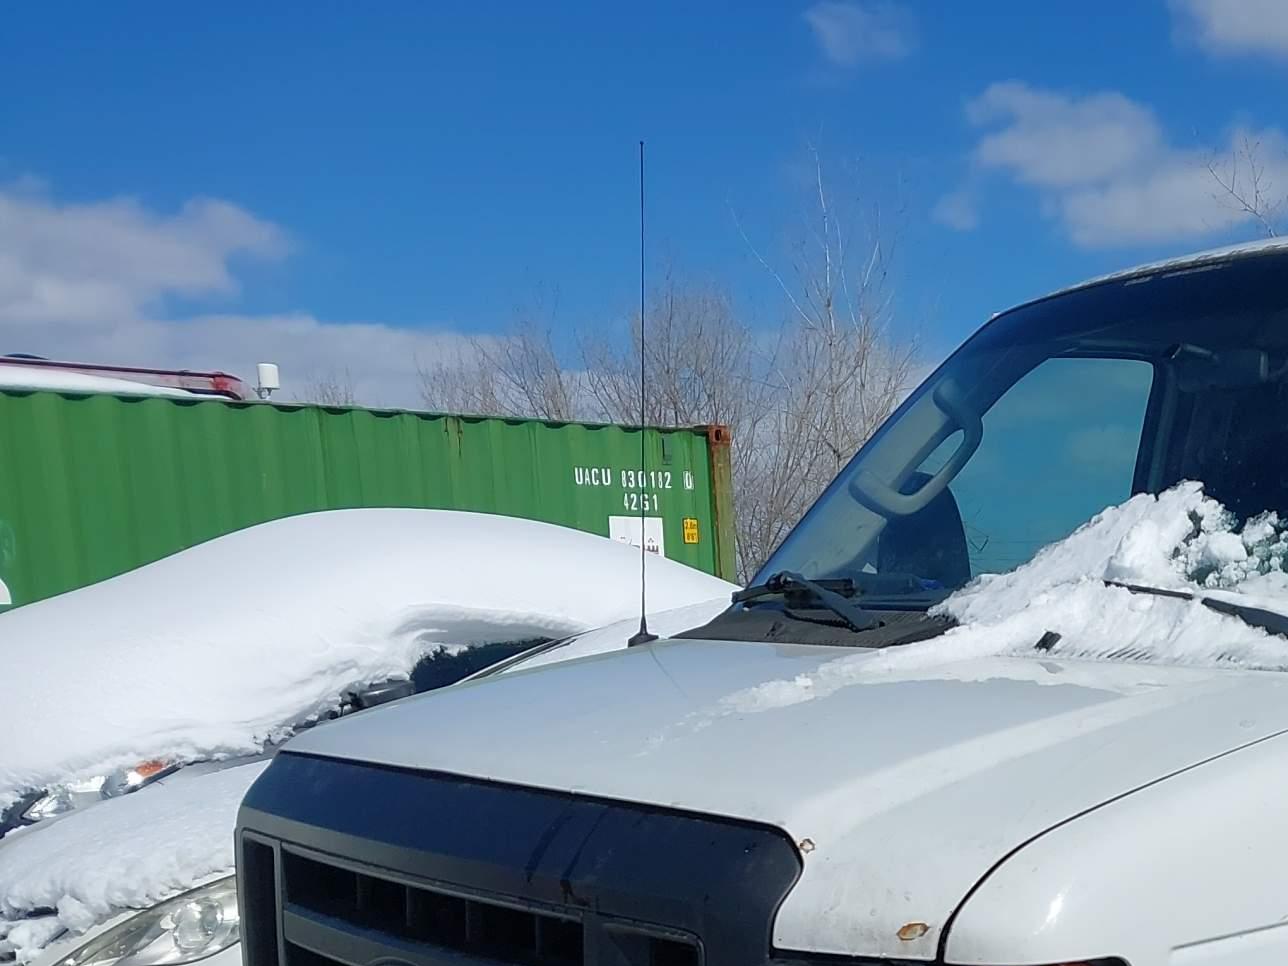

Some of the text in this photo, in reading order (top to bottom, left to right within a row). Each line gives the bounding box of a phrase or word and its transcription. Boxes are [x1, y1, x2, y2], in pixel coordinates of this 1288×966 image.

[574, 467, 611, 486] UACU
[621, 470, 672, 489] 830182
[623, 493, 658, 512] 42G1
